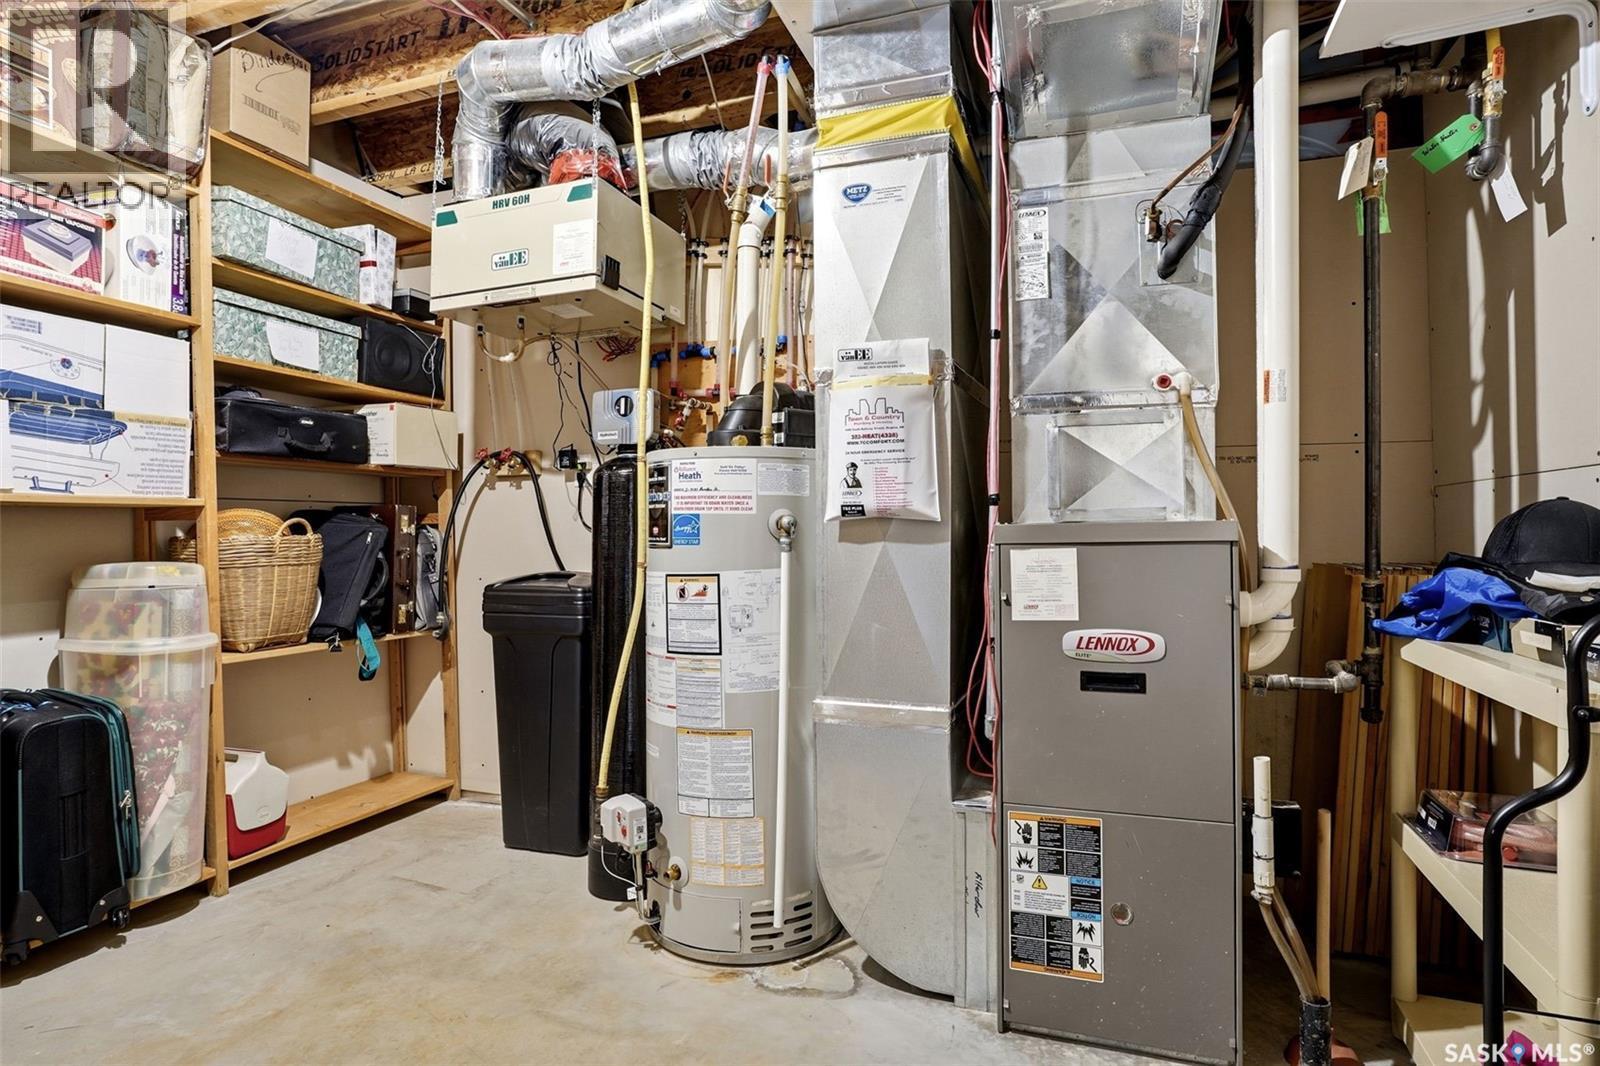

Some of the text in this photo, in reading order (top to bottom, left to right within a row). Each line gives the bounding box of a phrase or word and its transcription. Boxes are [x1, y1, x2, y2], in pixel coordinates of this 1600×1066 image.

[846, 186, 868, 195] METZ
[492, 194, 530, 210] HRV 60H
[678, 471, 702, 480] Heath
[1076, 636, 1139, 652] LENNOX
